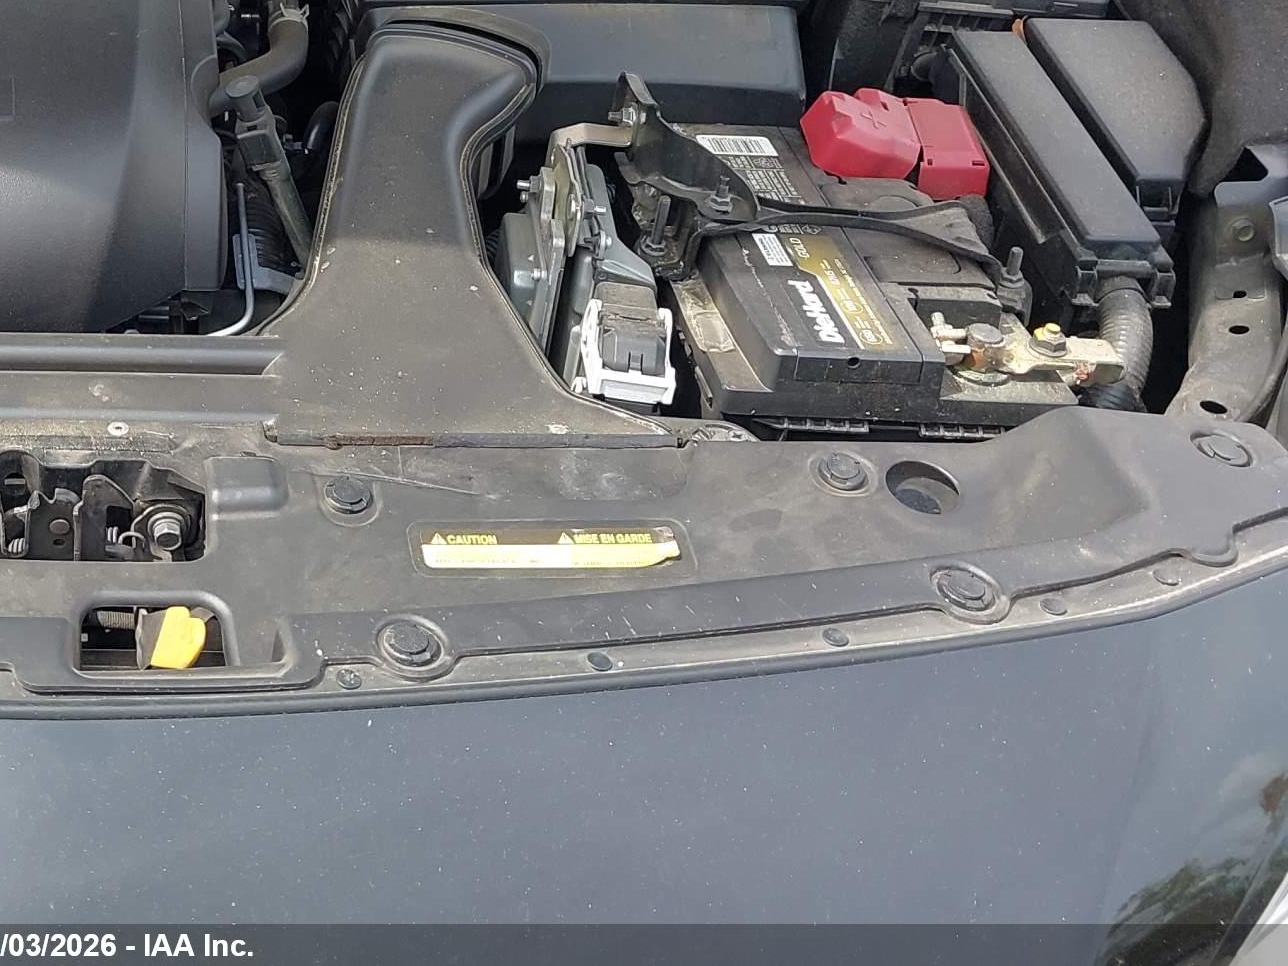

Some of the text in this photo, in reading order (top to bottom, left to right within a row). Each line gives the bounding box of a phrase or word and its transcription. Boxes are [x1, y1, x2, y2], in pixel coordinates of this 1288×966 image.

[789, 237, 810, 259] GOLD
[787, 280, 845, 343] DieHard
[446, 534, 498, 545] CAUTION
[573, 533, 653, 544] MISE EN GARDE
